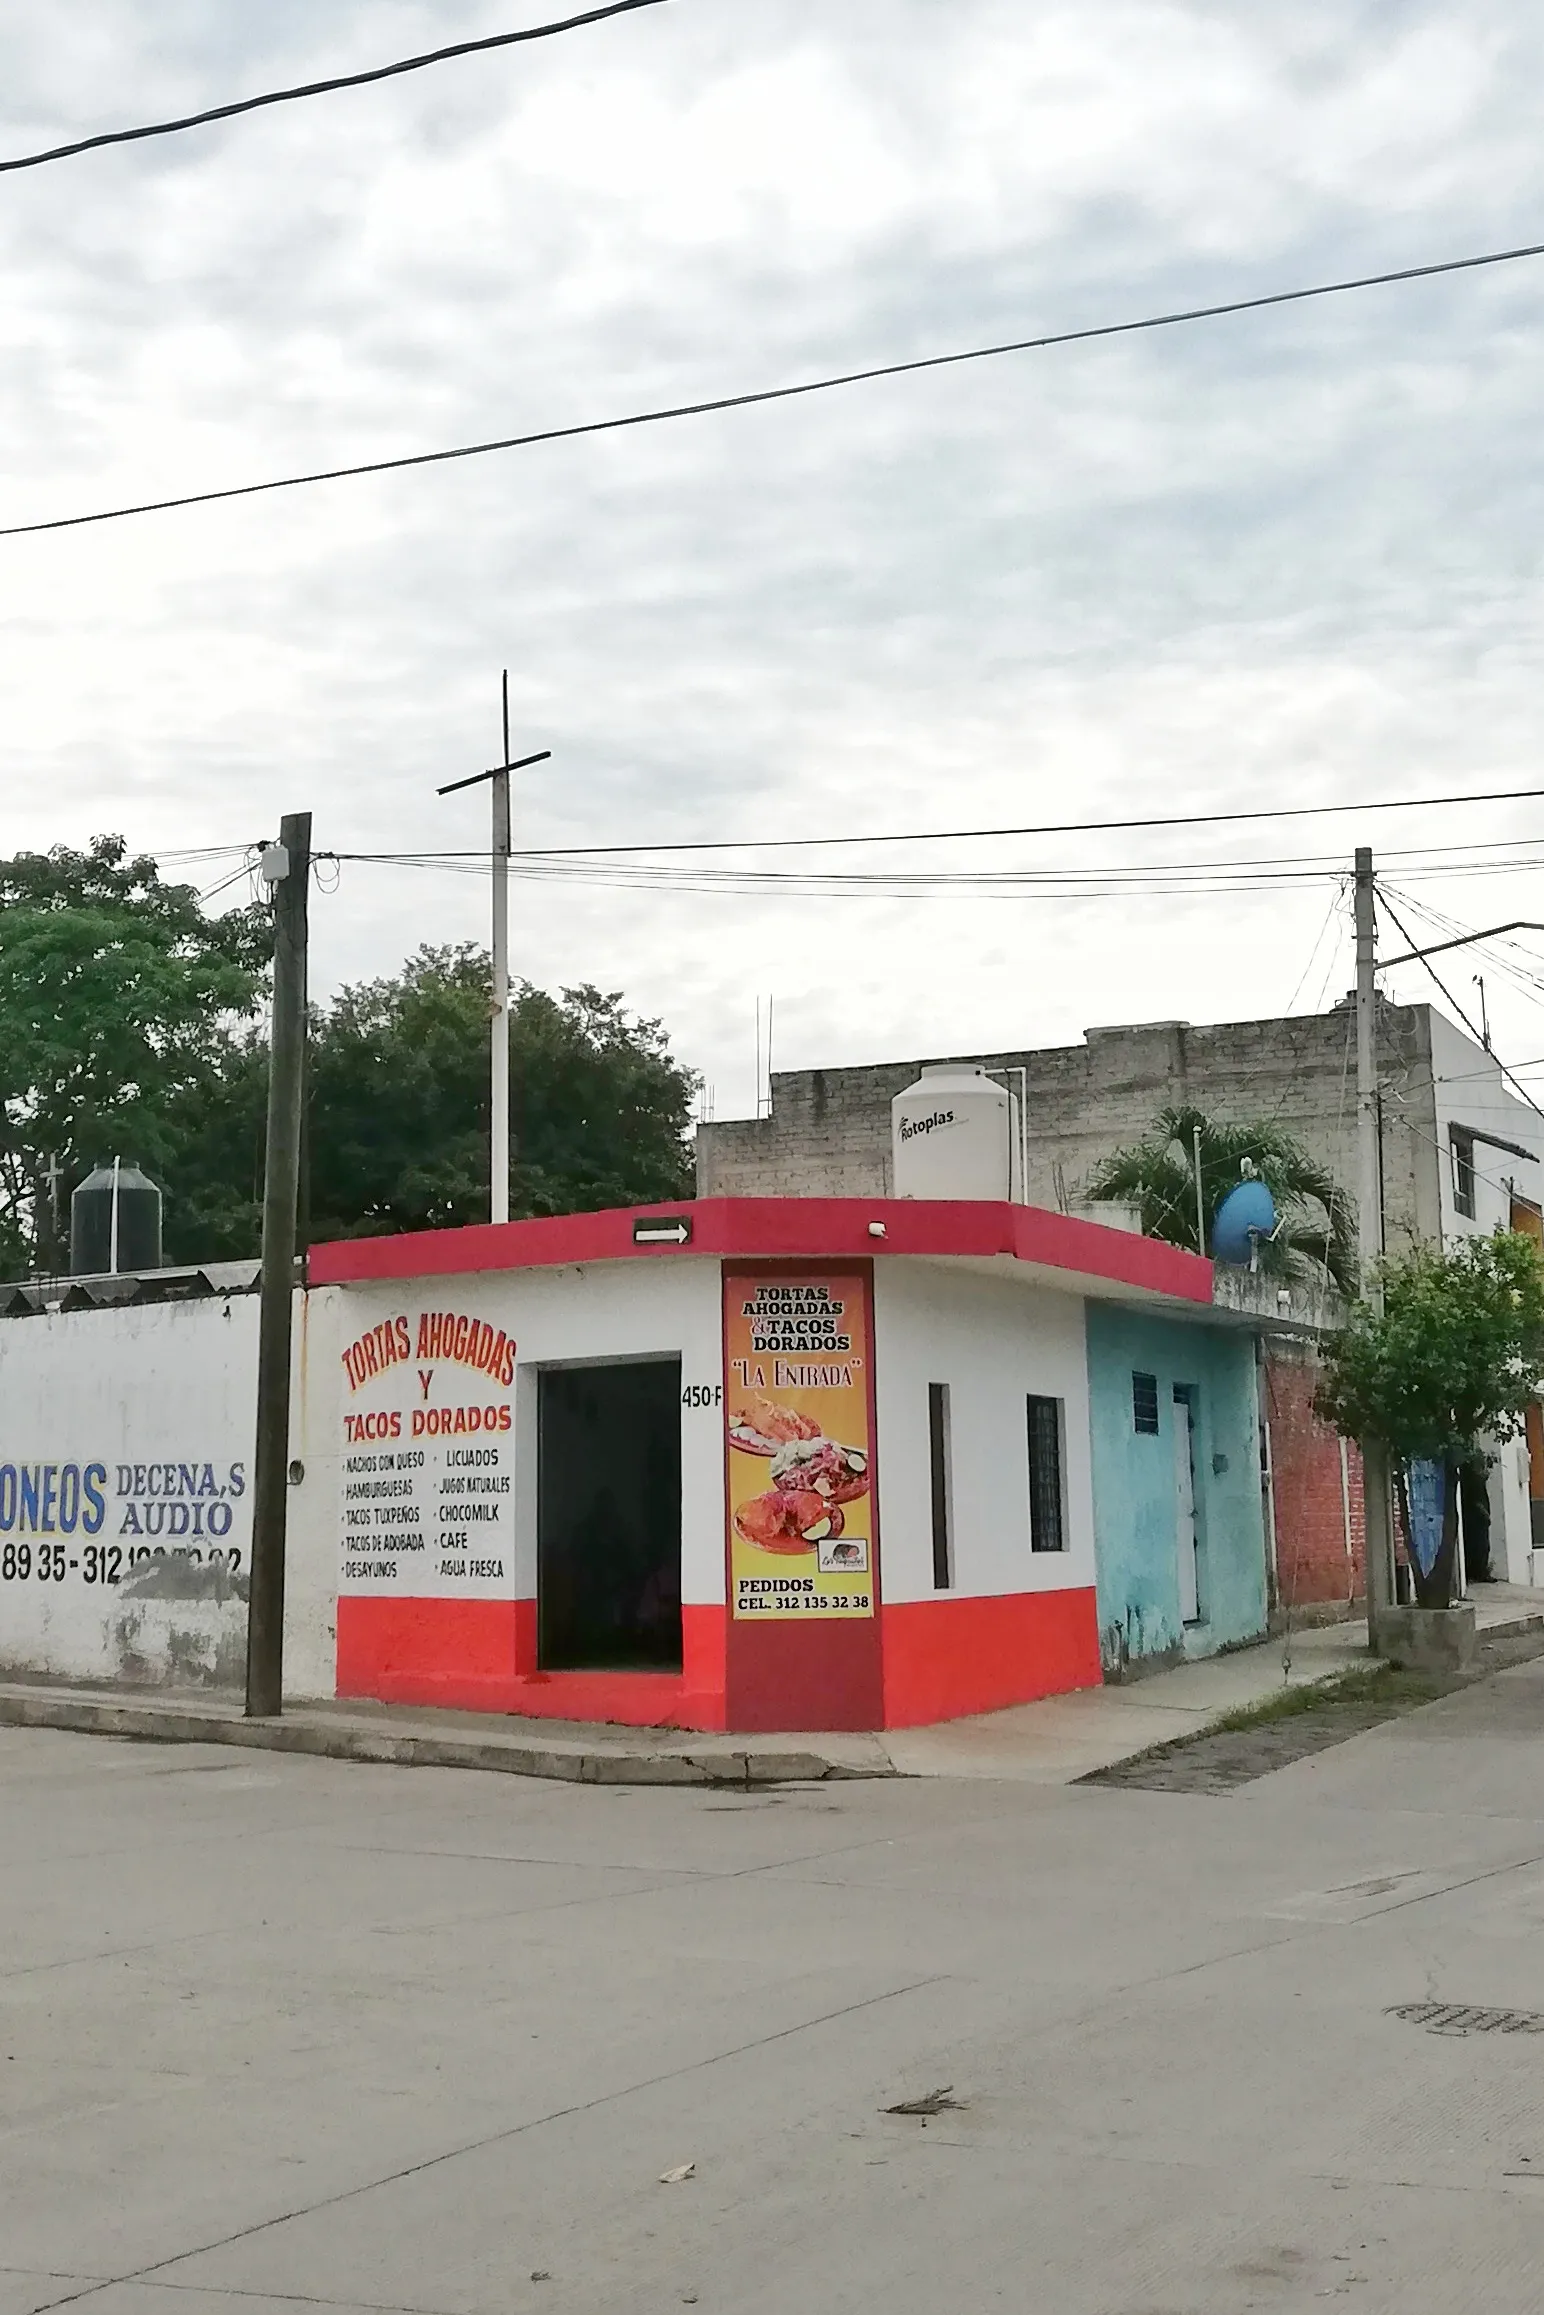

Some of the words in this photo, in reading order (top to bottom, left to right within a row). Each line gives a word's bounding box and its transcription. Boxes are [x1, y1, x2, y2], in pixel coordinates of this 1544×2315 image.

[901, 1110, 954, 1142] Rotoplas
[756, 1287, 829, 1301] TORTAS
[742, 1302, 843, 1315] AHOGADAS
[751, 1317, 765, 1335] &
[767, 1319, 835, 1334] TACOS
[341, 1315, 411, 1391] TORTAS
[416, 1312, 517, 1386] AHOGADAS
[754, 1336, 850, 1351] DORADOS
[417, 1369, 434, 1401] Y
[343, 1411, 402, 1443] TACOS
[412, 1404, 512, 1437] DORADOS
[379, 1454, 395, 1471] CON
[397, 1451, 425, 1471] QUESO
[446, 1448, 499, 1467] LICUADOS
[345, 1478, 413, 1500] HAMBURGUESAS
[439, 1477, 465, 1494] JUGOS
[466, 1476, 510, 1493] NATURALES
[119, 1501, 233, 1536] AUDIO
[346, 1508, 371, 1526] TACOS
[439, 1504, 499, 1522] CHOCOMILK
[346, 1535, 371, 1552] TACOS
[372, 1534, 382, 1551] DE
[383, 1533, 425, 1552] ADOBADA
[2, 1543, 32, 1581] 89
[345, 1561, 397, 1578] DESAYUNOS
[440, 1560, 466, 1576] AGUA
[469, 1559, 504, 1577] FRESCA
[739, 1579, 814, 1592] PEDIDOS
[738, 1598, 772, 1609] CEL.
[775, 1597, 800, 1609] 312
[804, 1597, 828, 1608] 135
[832, 1596, 849, 1608] 32
[852, 1596, 869, 1608] 38
